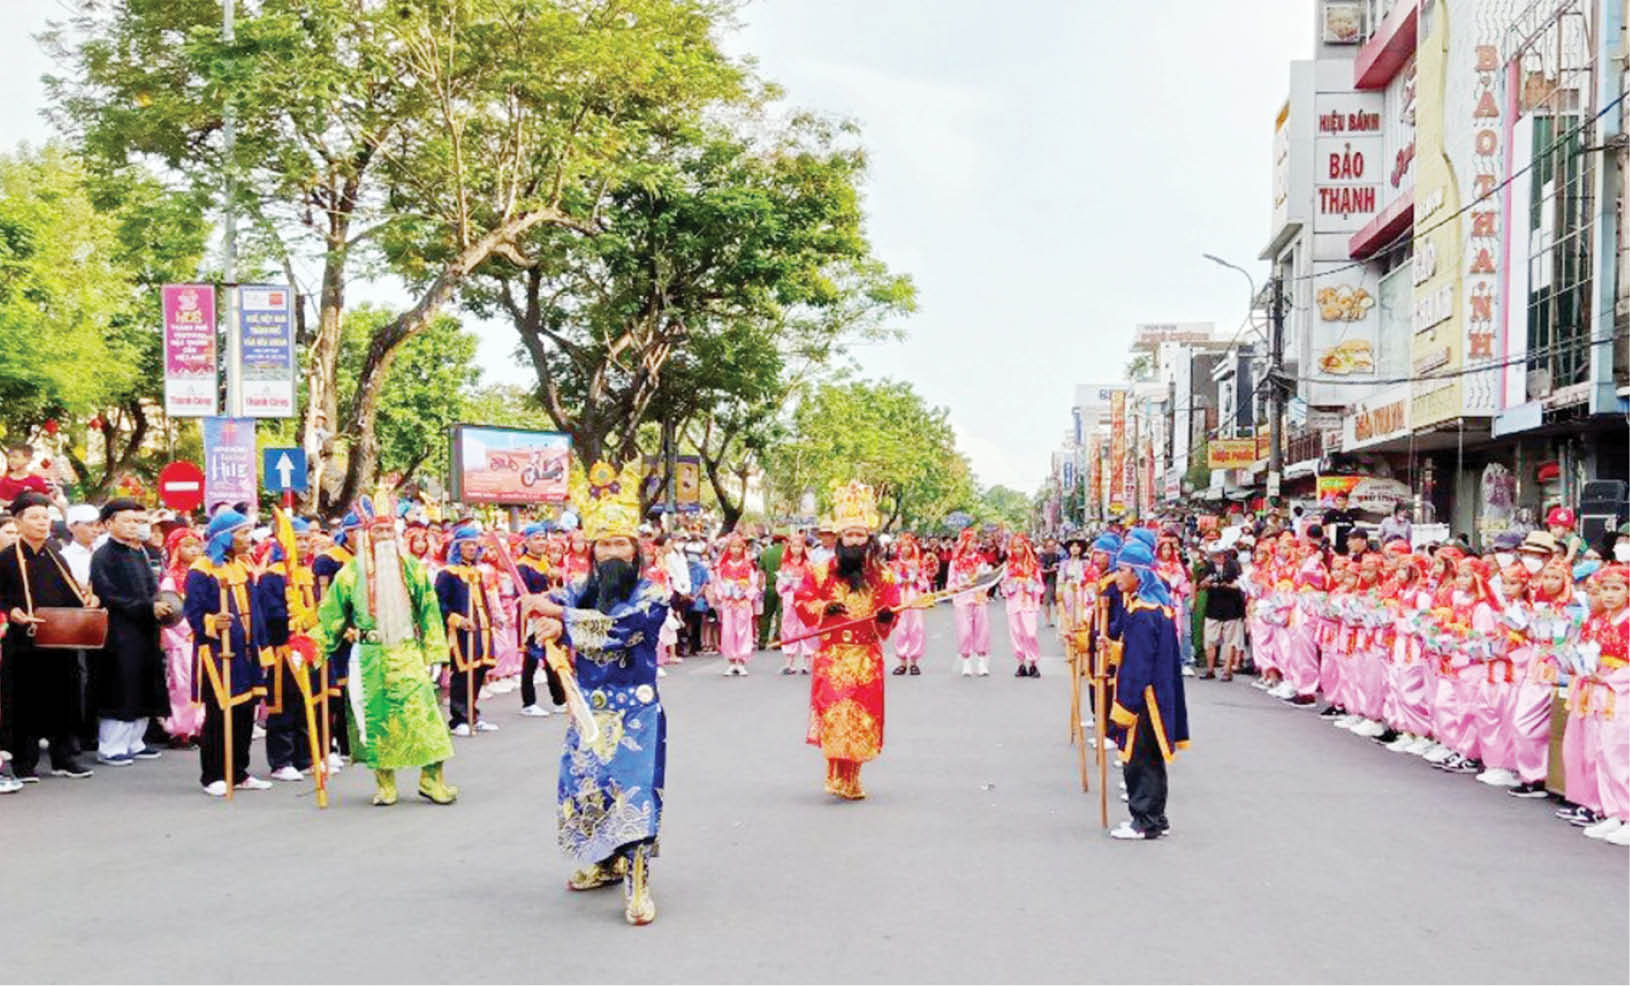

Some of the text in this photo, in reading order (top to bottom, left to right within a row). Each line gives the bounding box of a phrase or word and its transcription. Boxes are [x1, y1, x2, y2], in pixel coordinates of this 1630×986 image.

[1319, 109, 1380, 135] HIỆU BÁNH
[1329, 142, 1364, 179] BẢO
[1319, 188, 1375, 220] THẠNH
